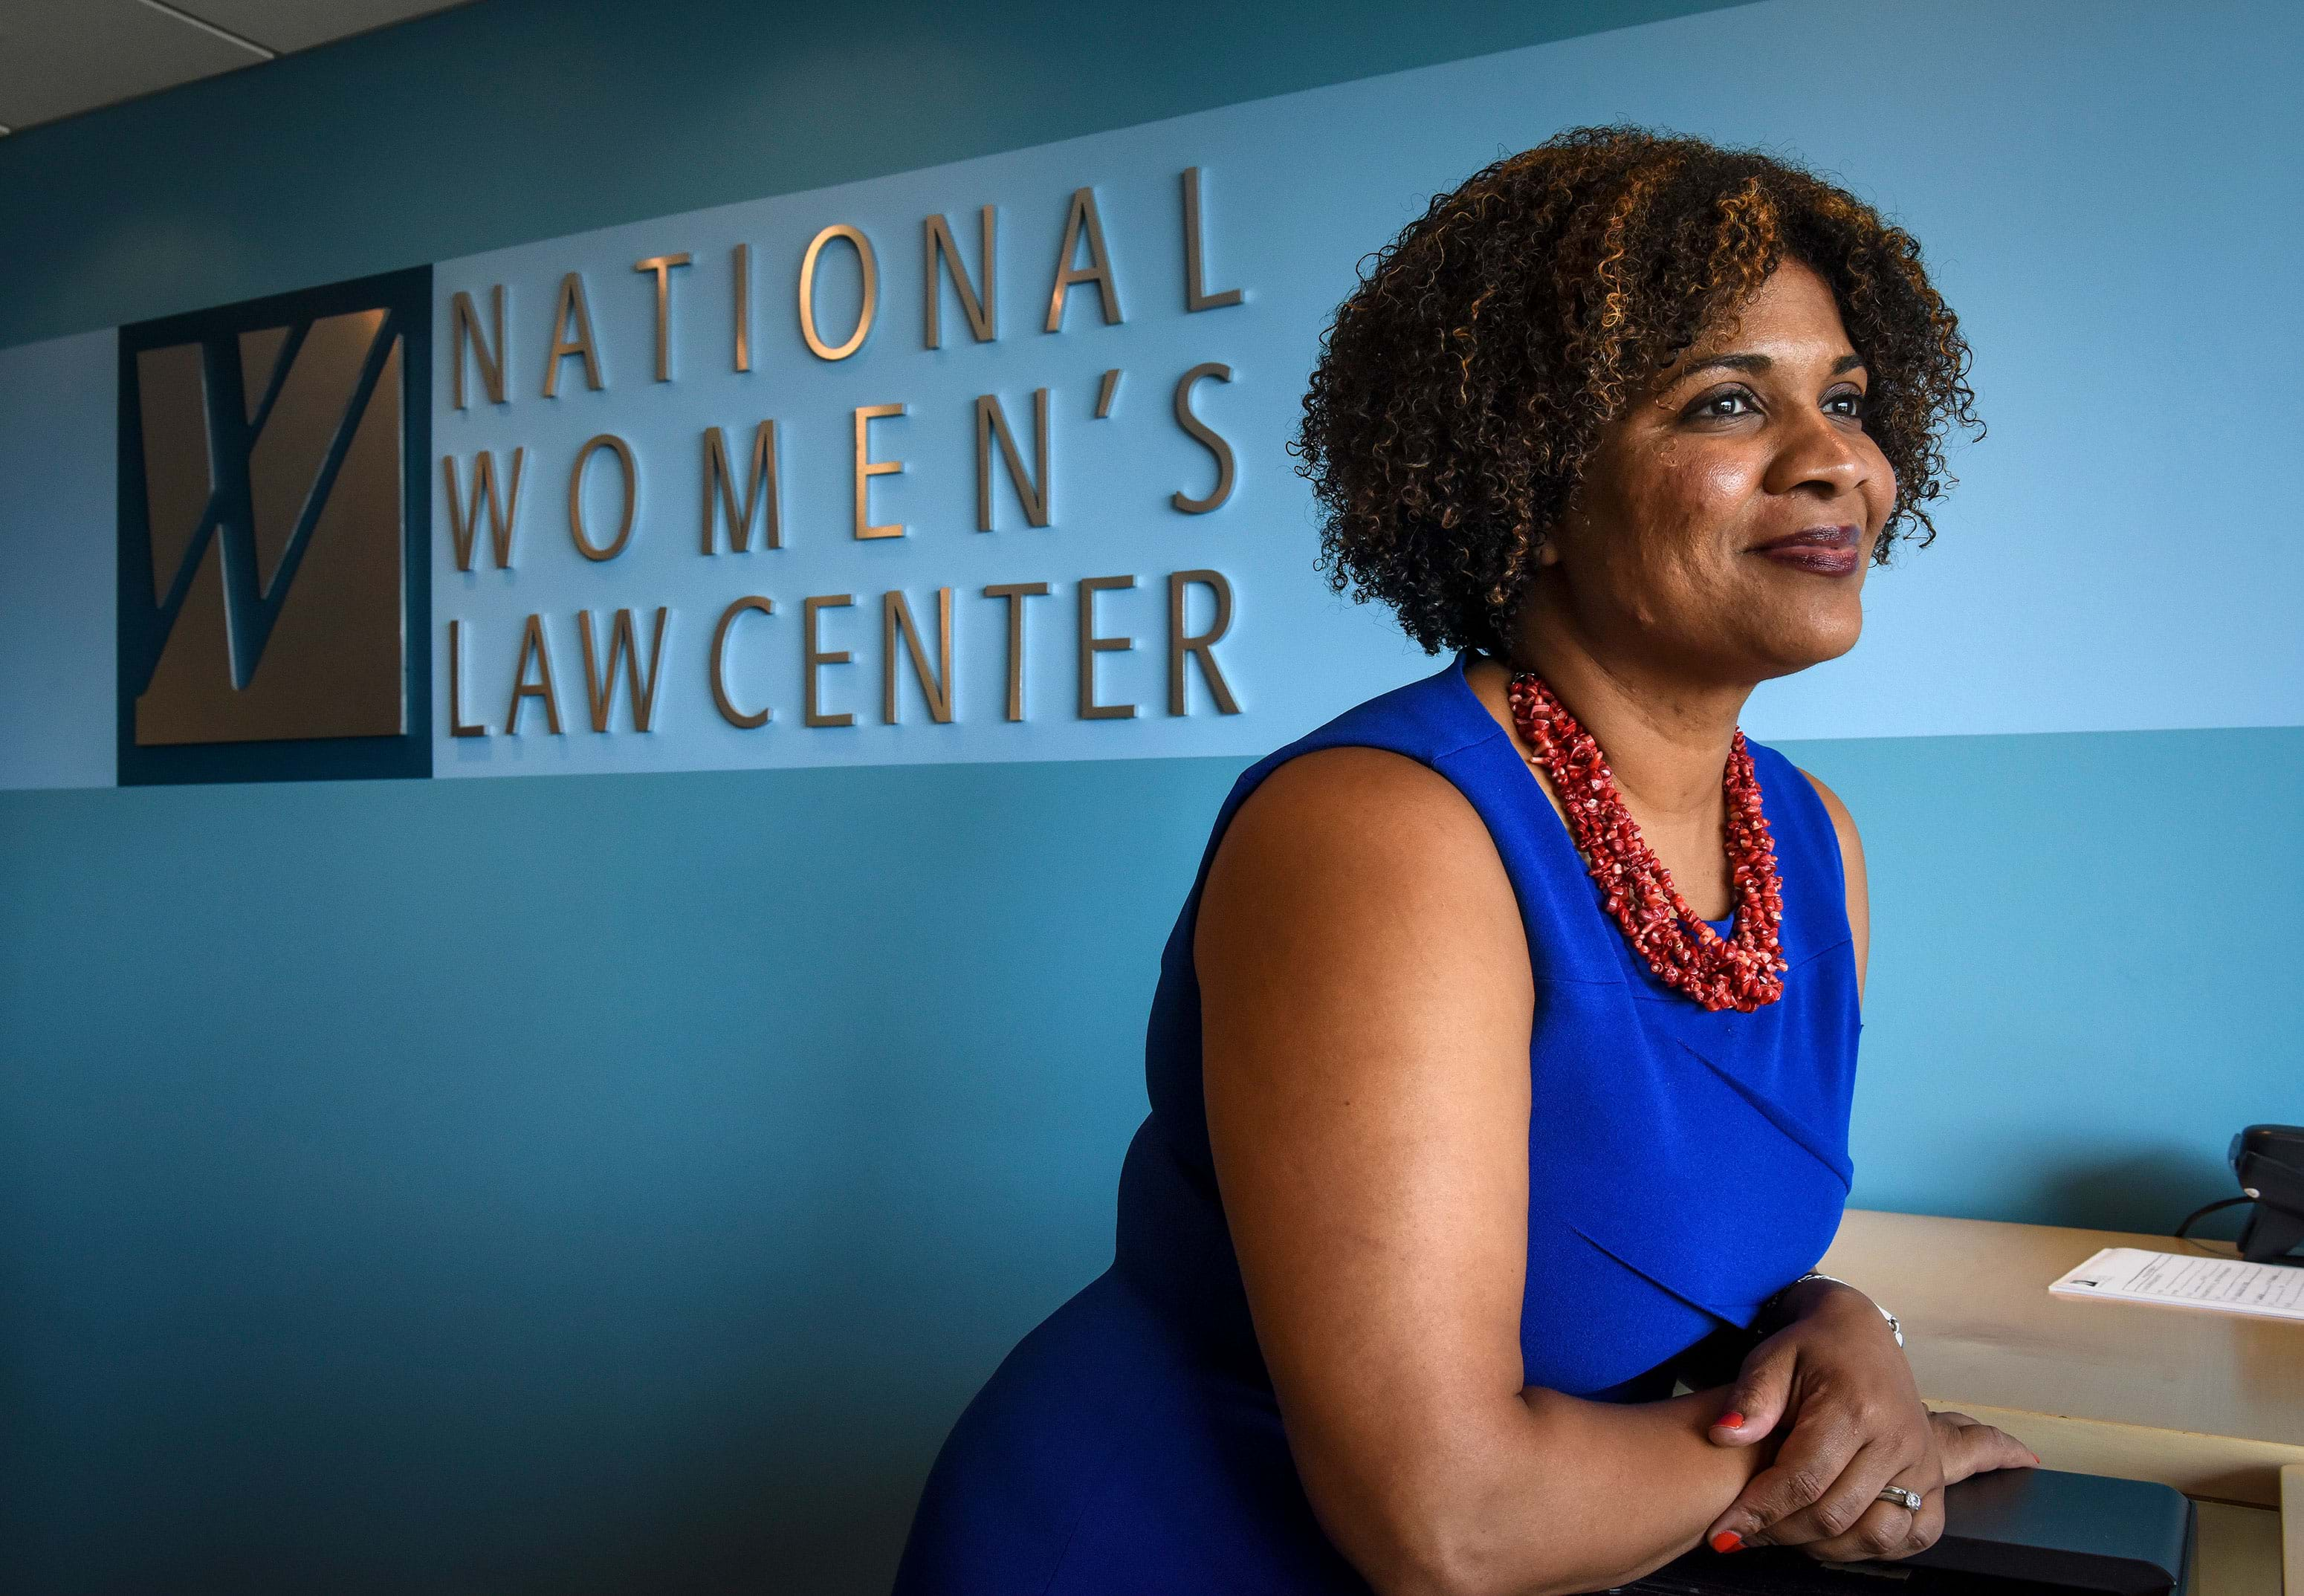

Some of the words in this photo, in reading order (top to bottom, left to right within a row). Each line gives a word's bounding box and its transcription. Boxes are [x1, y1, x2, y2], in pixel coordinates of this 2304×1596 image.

[450, 166, 1245, 409] NATIONAL
[444, 362, 1235, 571] WOMEN'S
[449, 606, 667, 736] LAW
[711, 569, 1243, 729] CENTER
